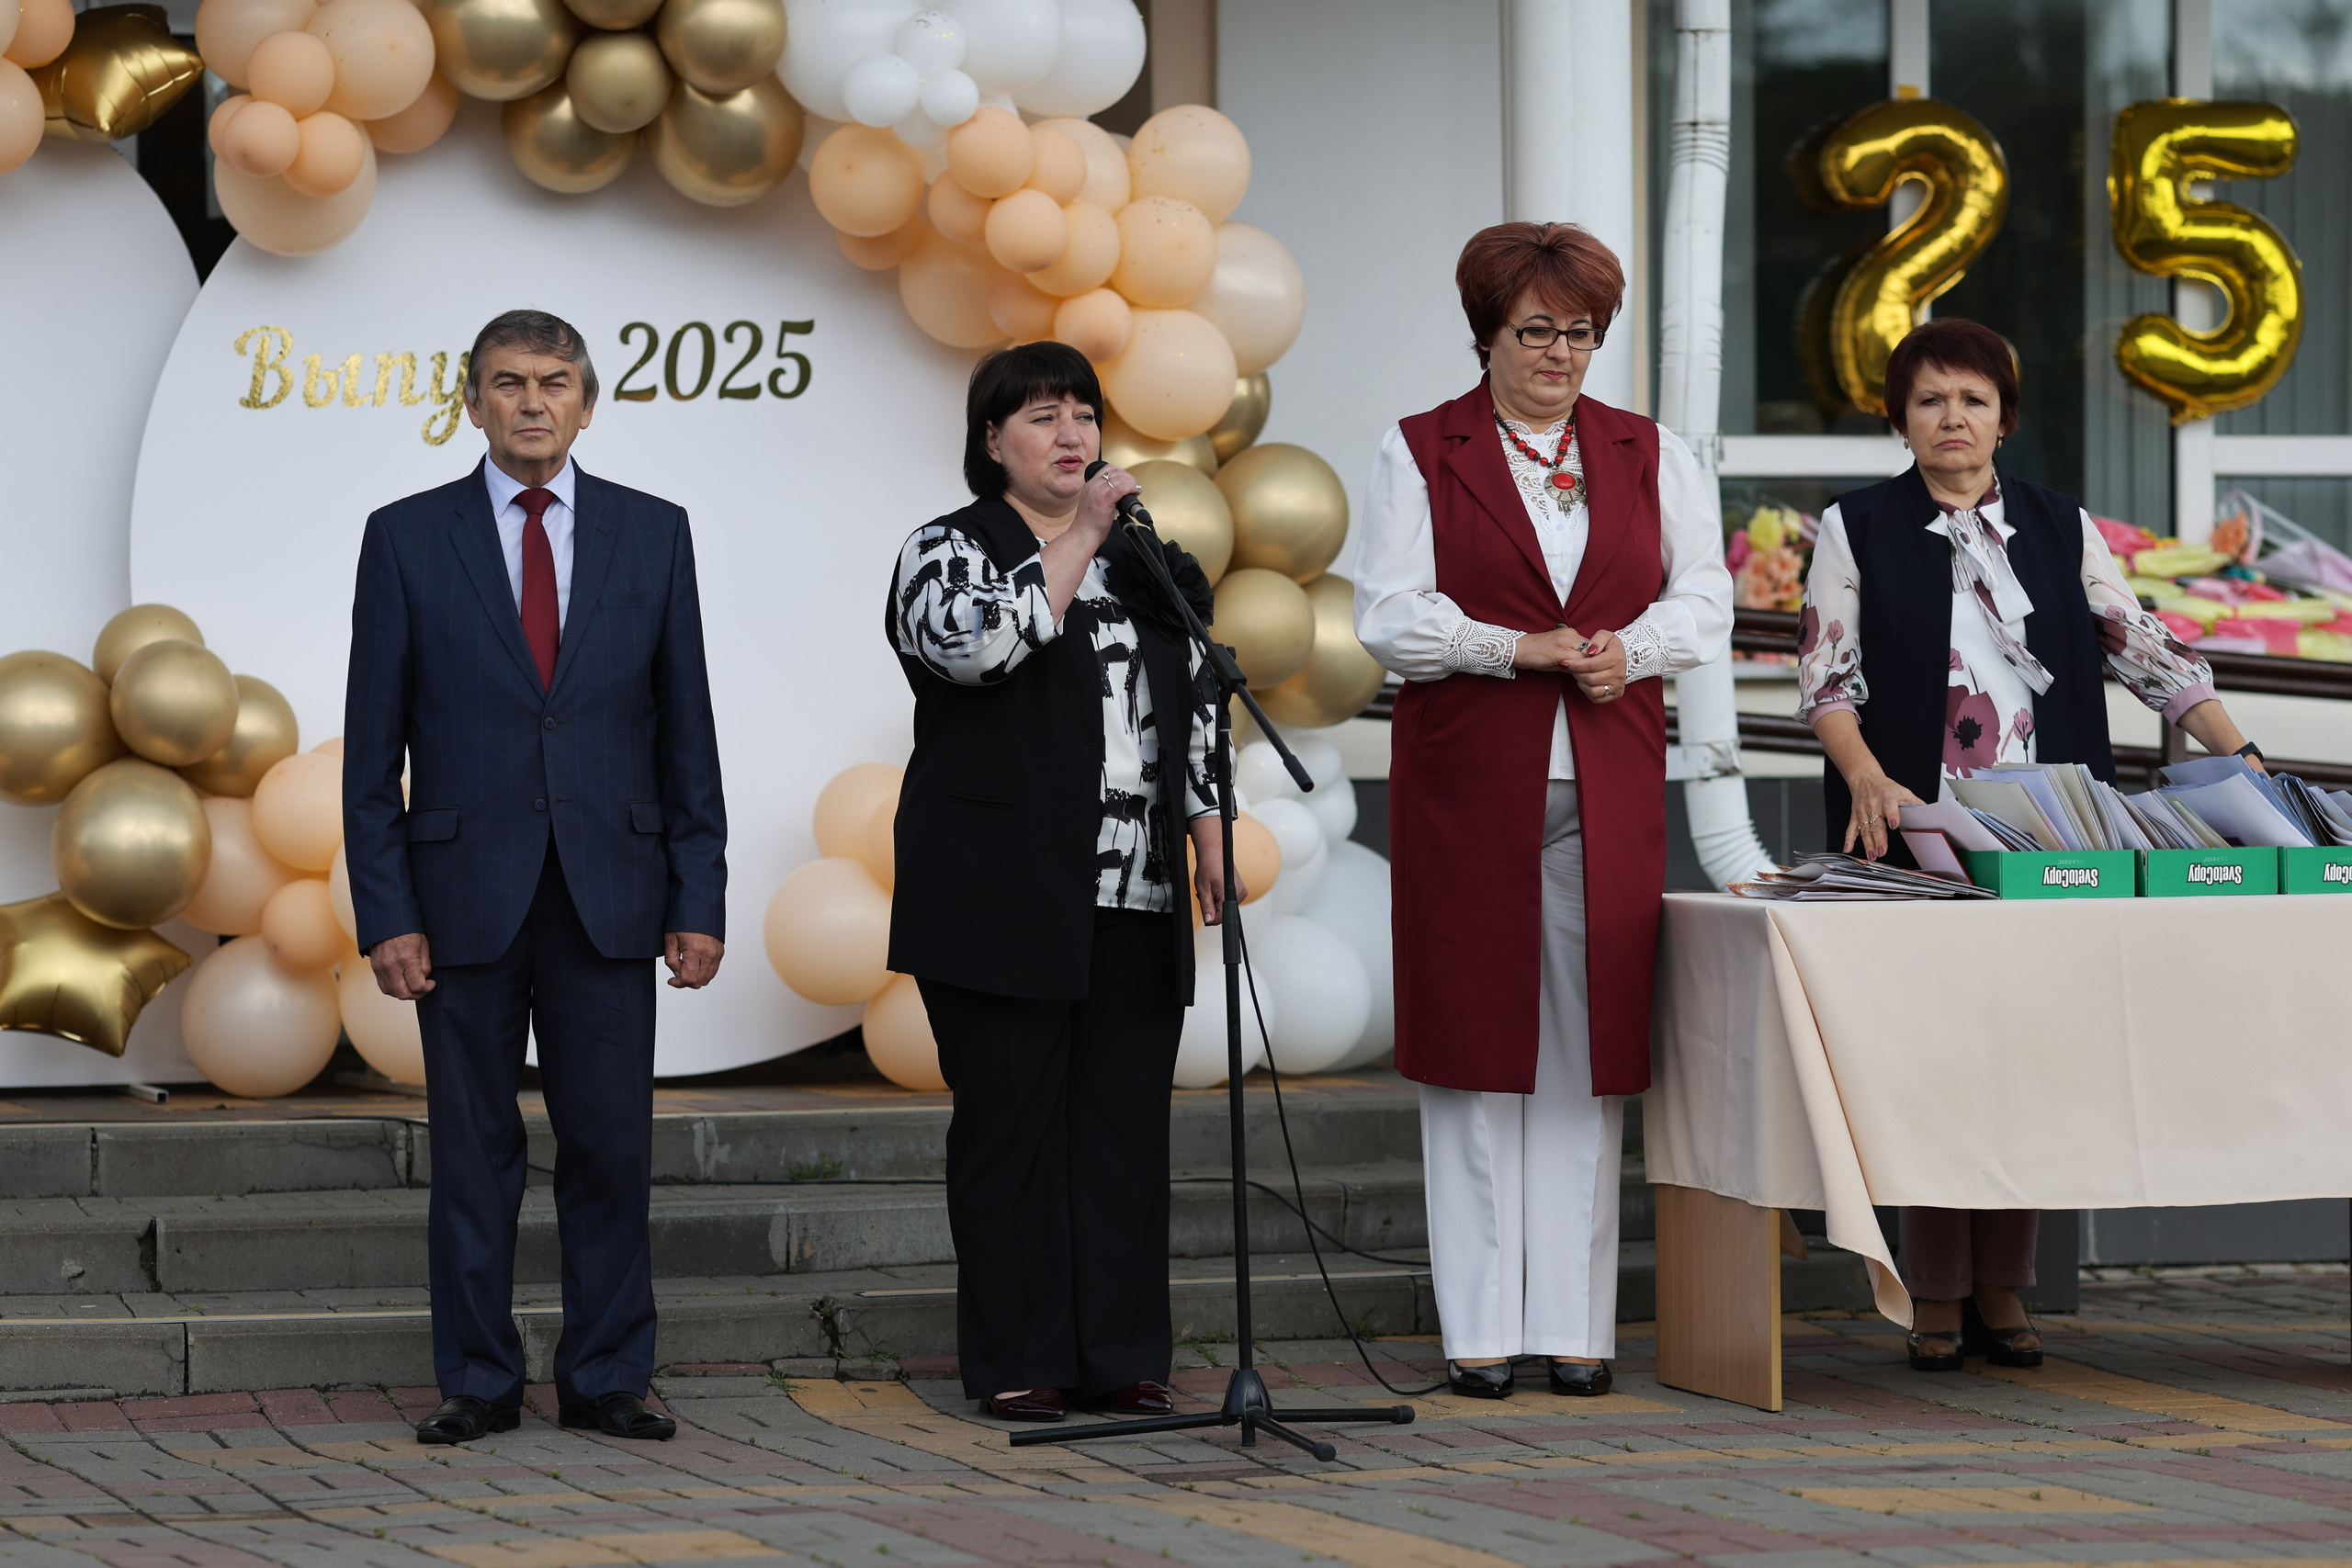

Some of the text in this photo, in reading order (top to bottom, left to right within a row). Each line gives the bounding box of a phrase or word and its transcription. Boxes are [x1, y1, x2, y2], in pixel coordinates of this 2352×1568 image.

[235, 319, 814, 446] Выпу 2025
[2042, 865, 2099, 888] SvetoCopy
[2187, 863, 2243, 886] SvetoCopy
